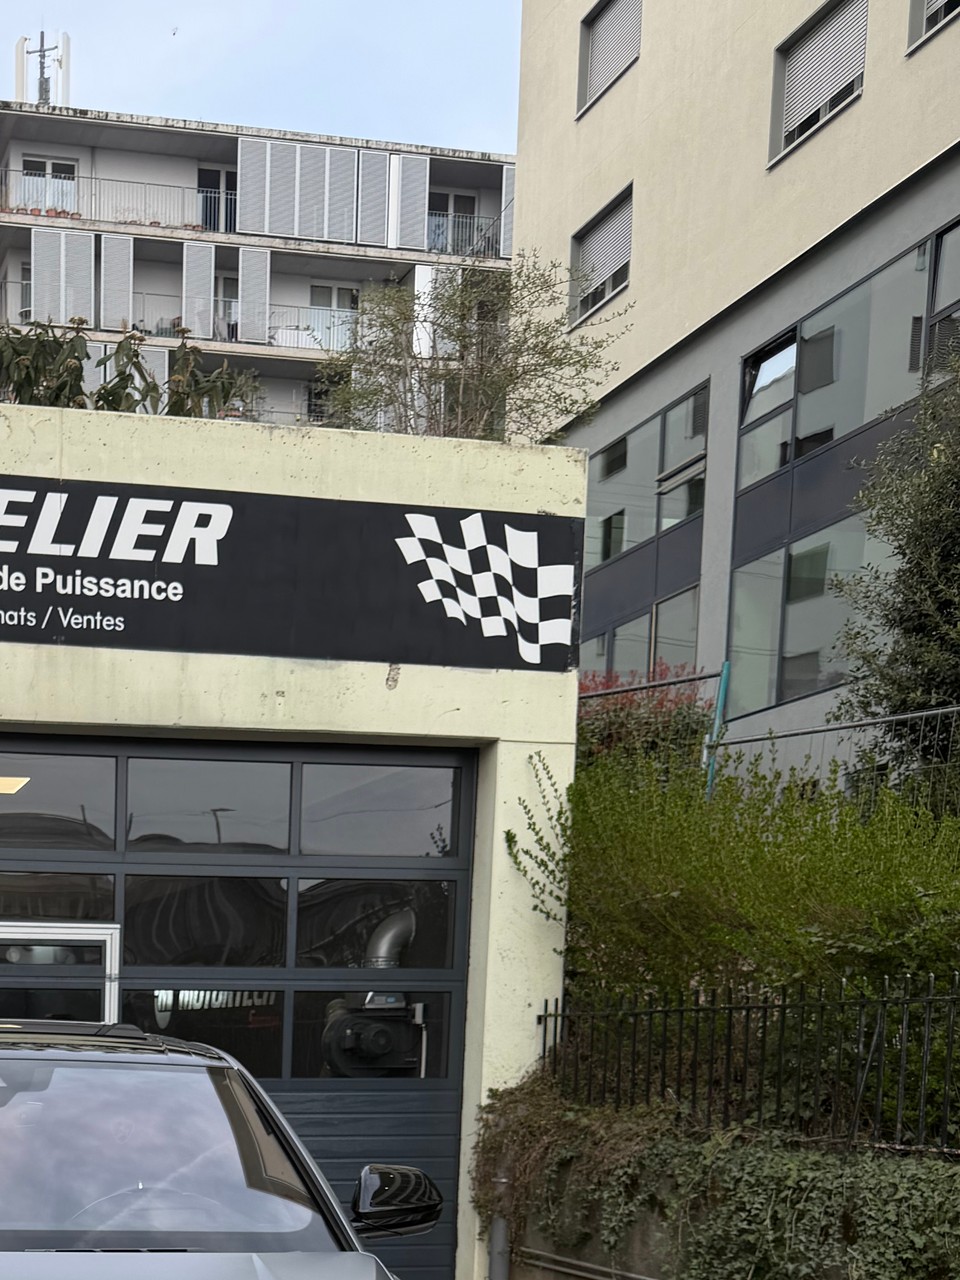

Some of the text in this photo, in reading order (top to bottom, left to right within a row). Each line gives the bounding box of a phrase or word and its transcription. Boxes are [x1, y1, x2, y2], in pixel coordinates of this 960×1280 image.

[35, 567, 184, 601] Puissance
[41, 606, 53, 630] /
[57, 607, 125, 631] Ventes
